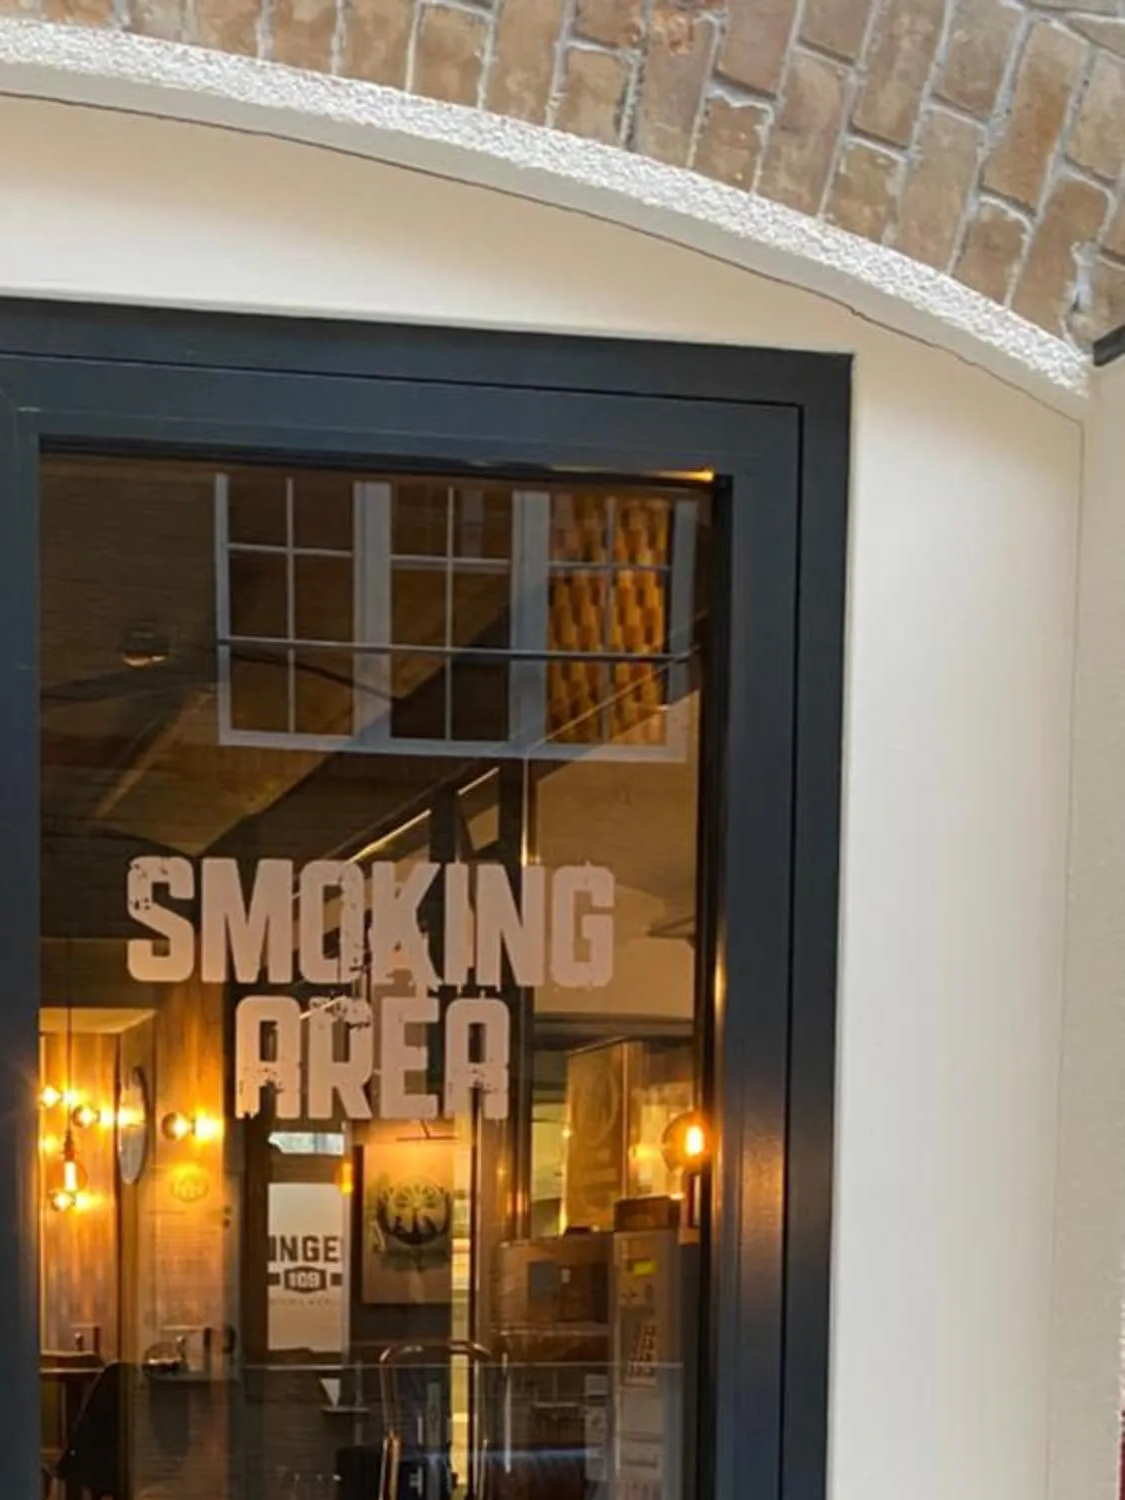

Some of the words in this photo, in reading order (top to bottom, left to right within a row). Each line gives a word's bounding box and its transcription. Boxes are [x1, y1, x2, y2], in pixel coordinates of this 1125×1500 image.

[126, 855, 615, 989] SMOKING
[236, 994, 511, 1120] AREA
[268, 1234, 340, 1263] INGE
